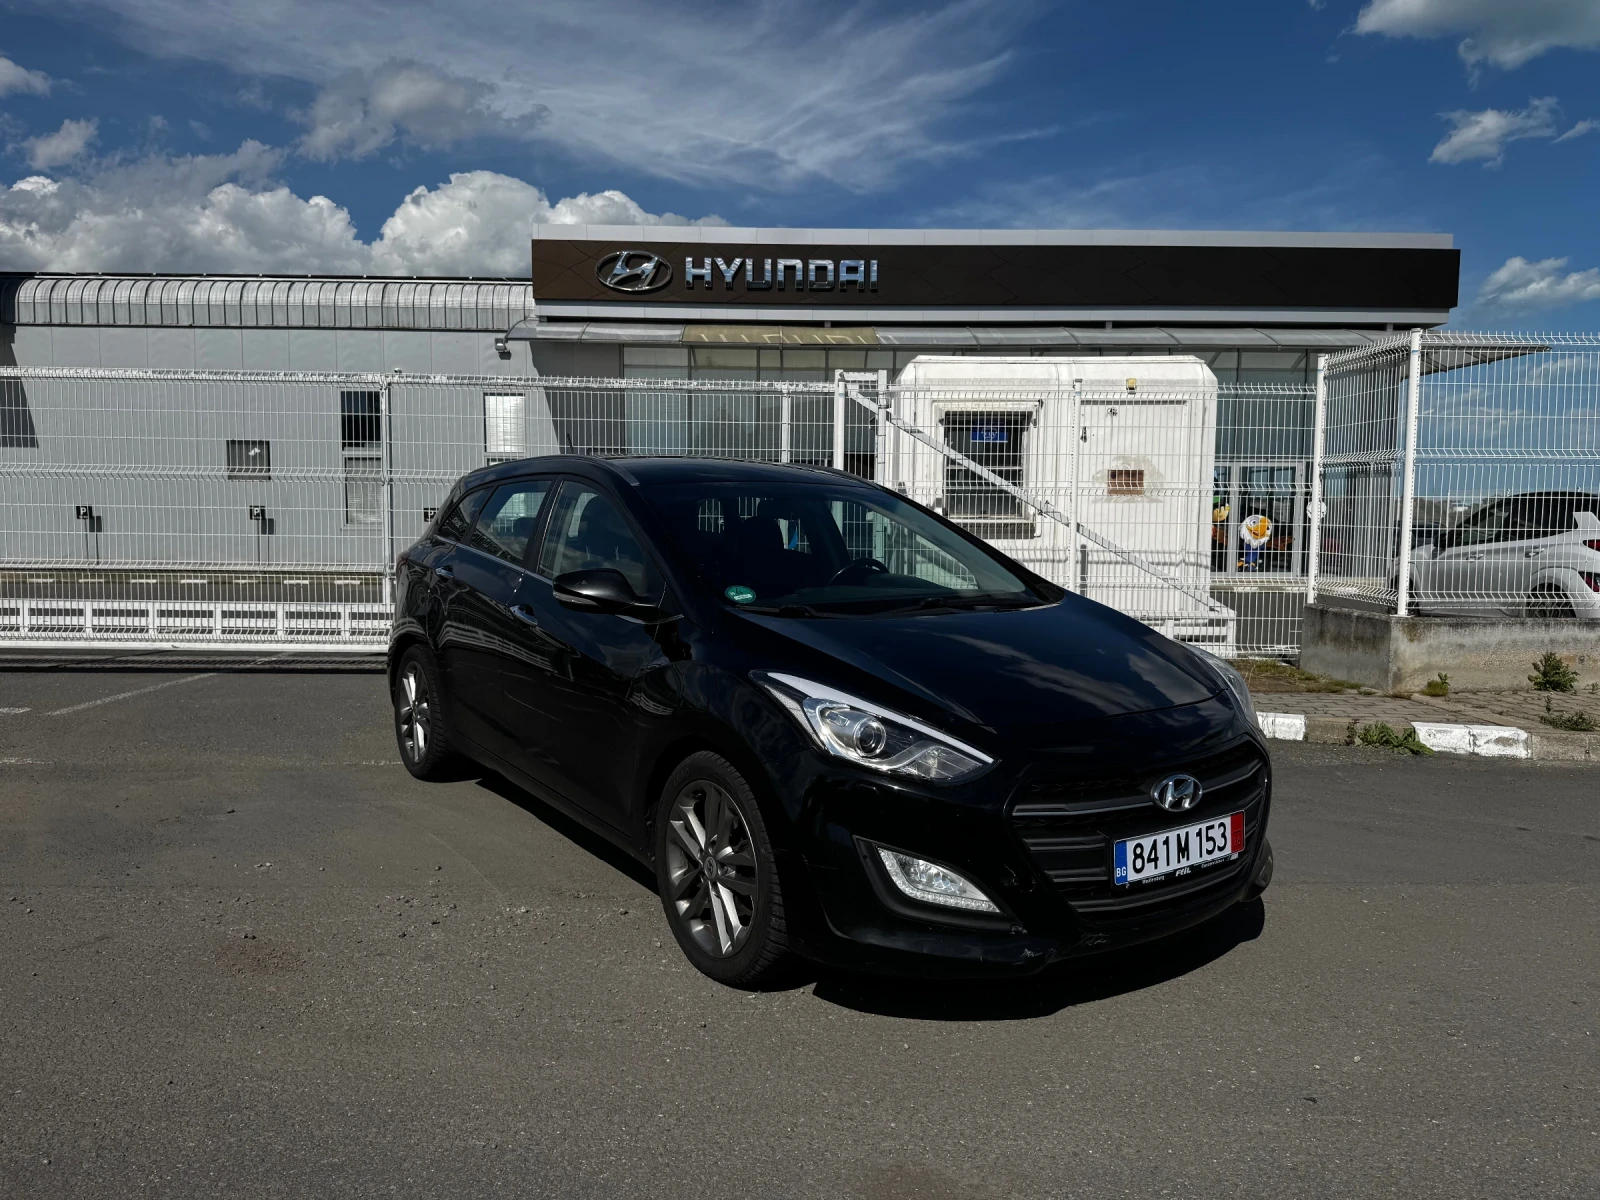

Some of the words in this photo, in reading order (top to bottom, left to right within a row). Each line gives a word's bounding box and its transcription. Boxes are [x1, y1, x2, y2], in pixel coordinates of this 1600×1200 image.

[685, 256, 879, 290] HYUNDAI
[1132, 835, 1170, 874] 841
[1176, 830, 1190, 864] M
[1195, 821, 1228, 858] 153
[1116, 866, 1127, 878] BG
